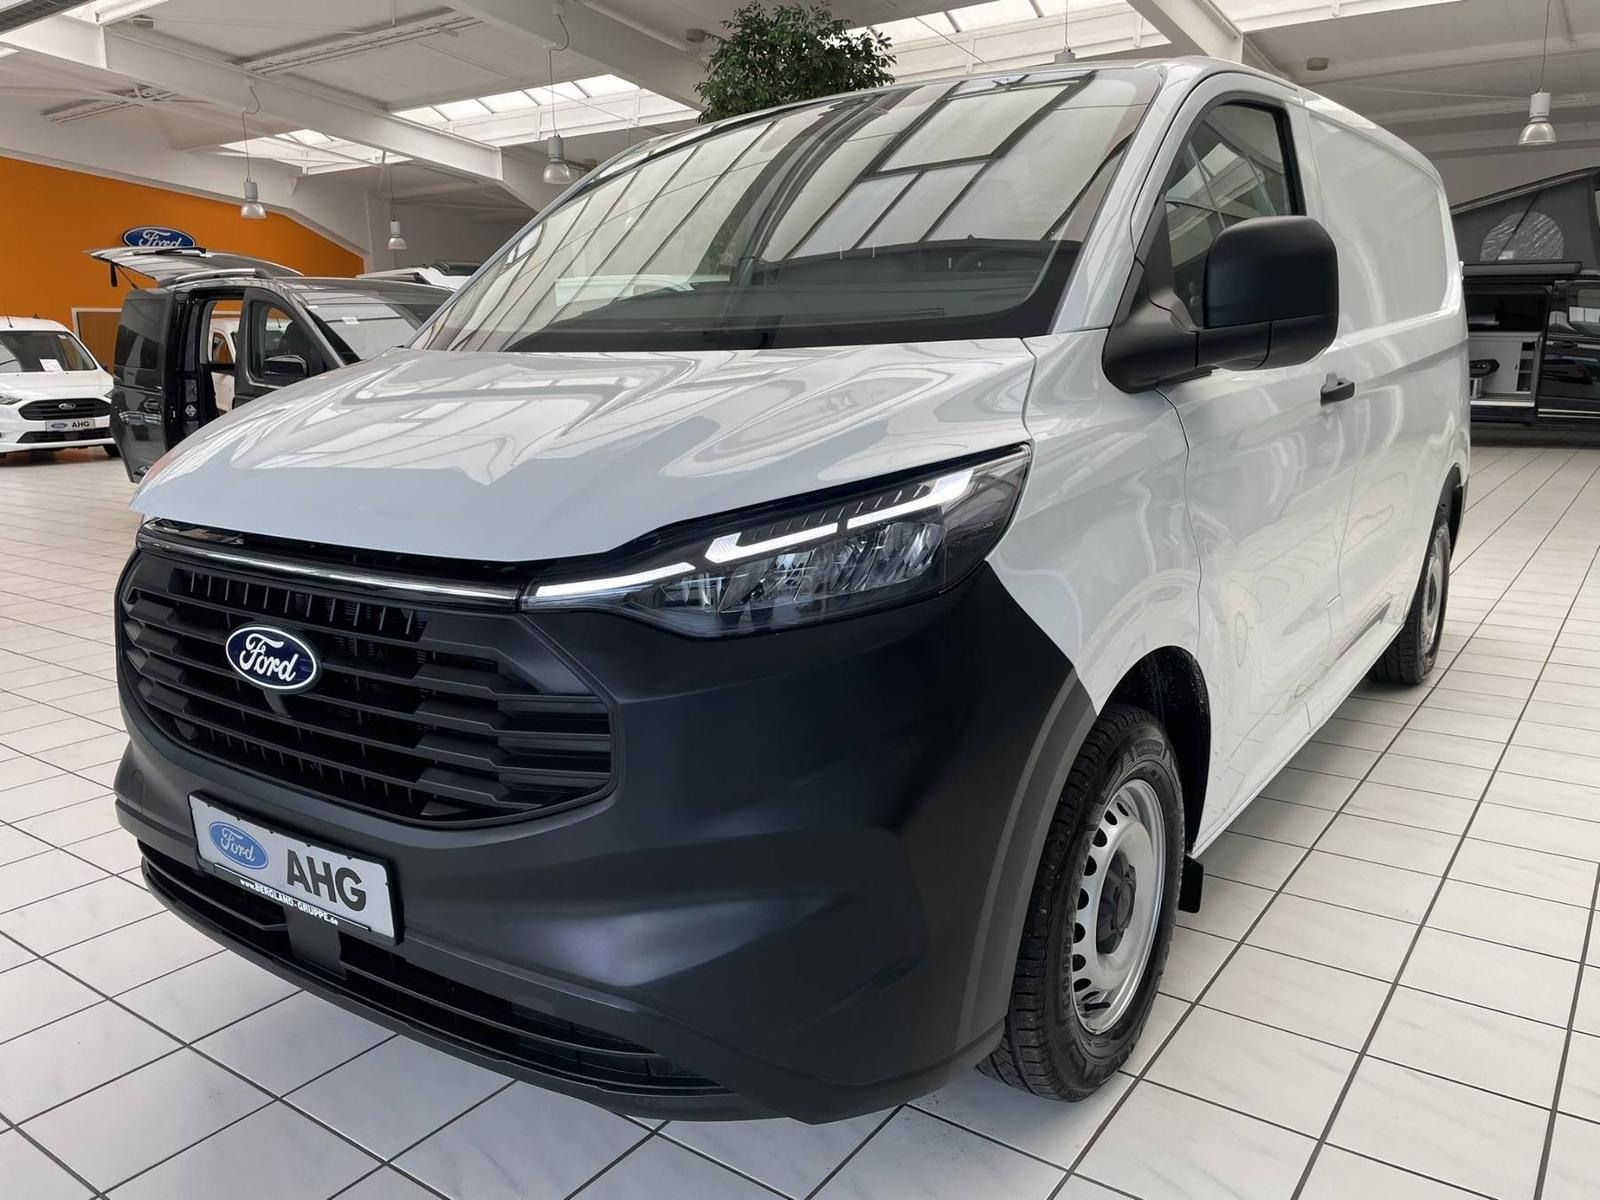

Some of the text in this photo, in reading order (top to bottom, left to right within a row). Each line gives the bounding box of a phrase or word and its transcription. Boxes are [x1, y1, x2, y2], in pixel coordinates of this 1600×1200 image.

[138, 229, 183, 248] Ford
[71, 420, 90, 428] AHG
[239, 632, 299, 682] Ford
[220, 826, 256, 862] Ford
[286, 849, 367, 912] AHG
